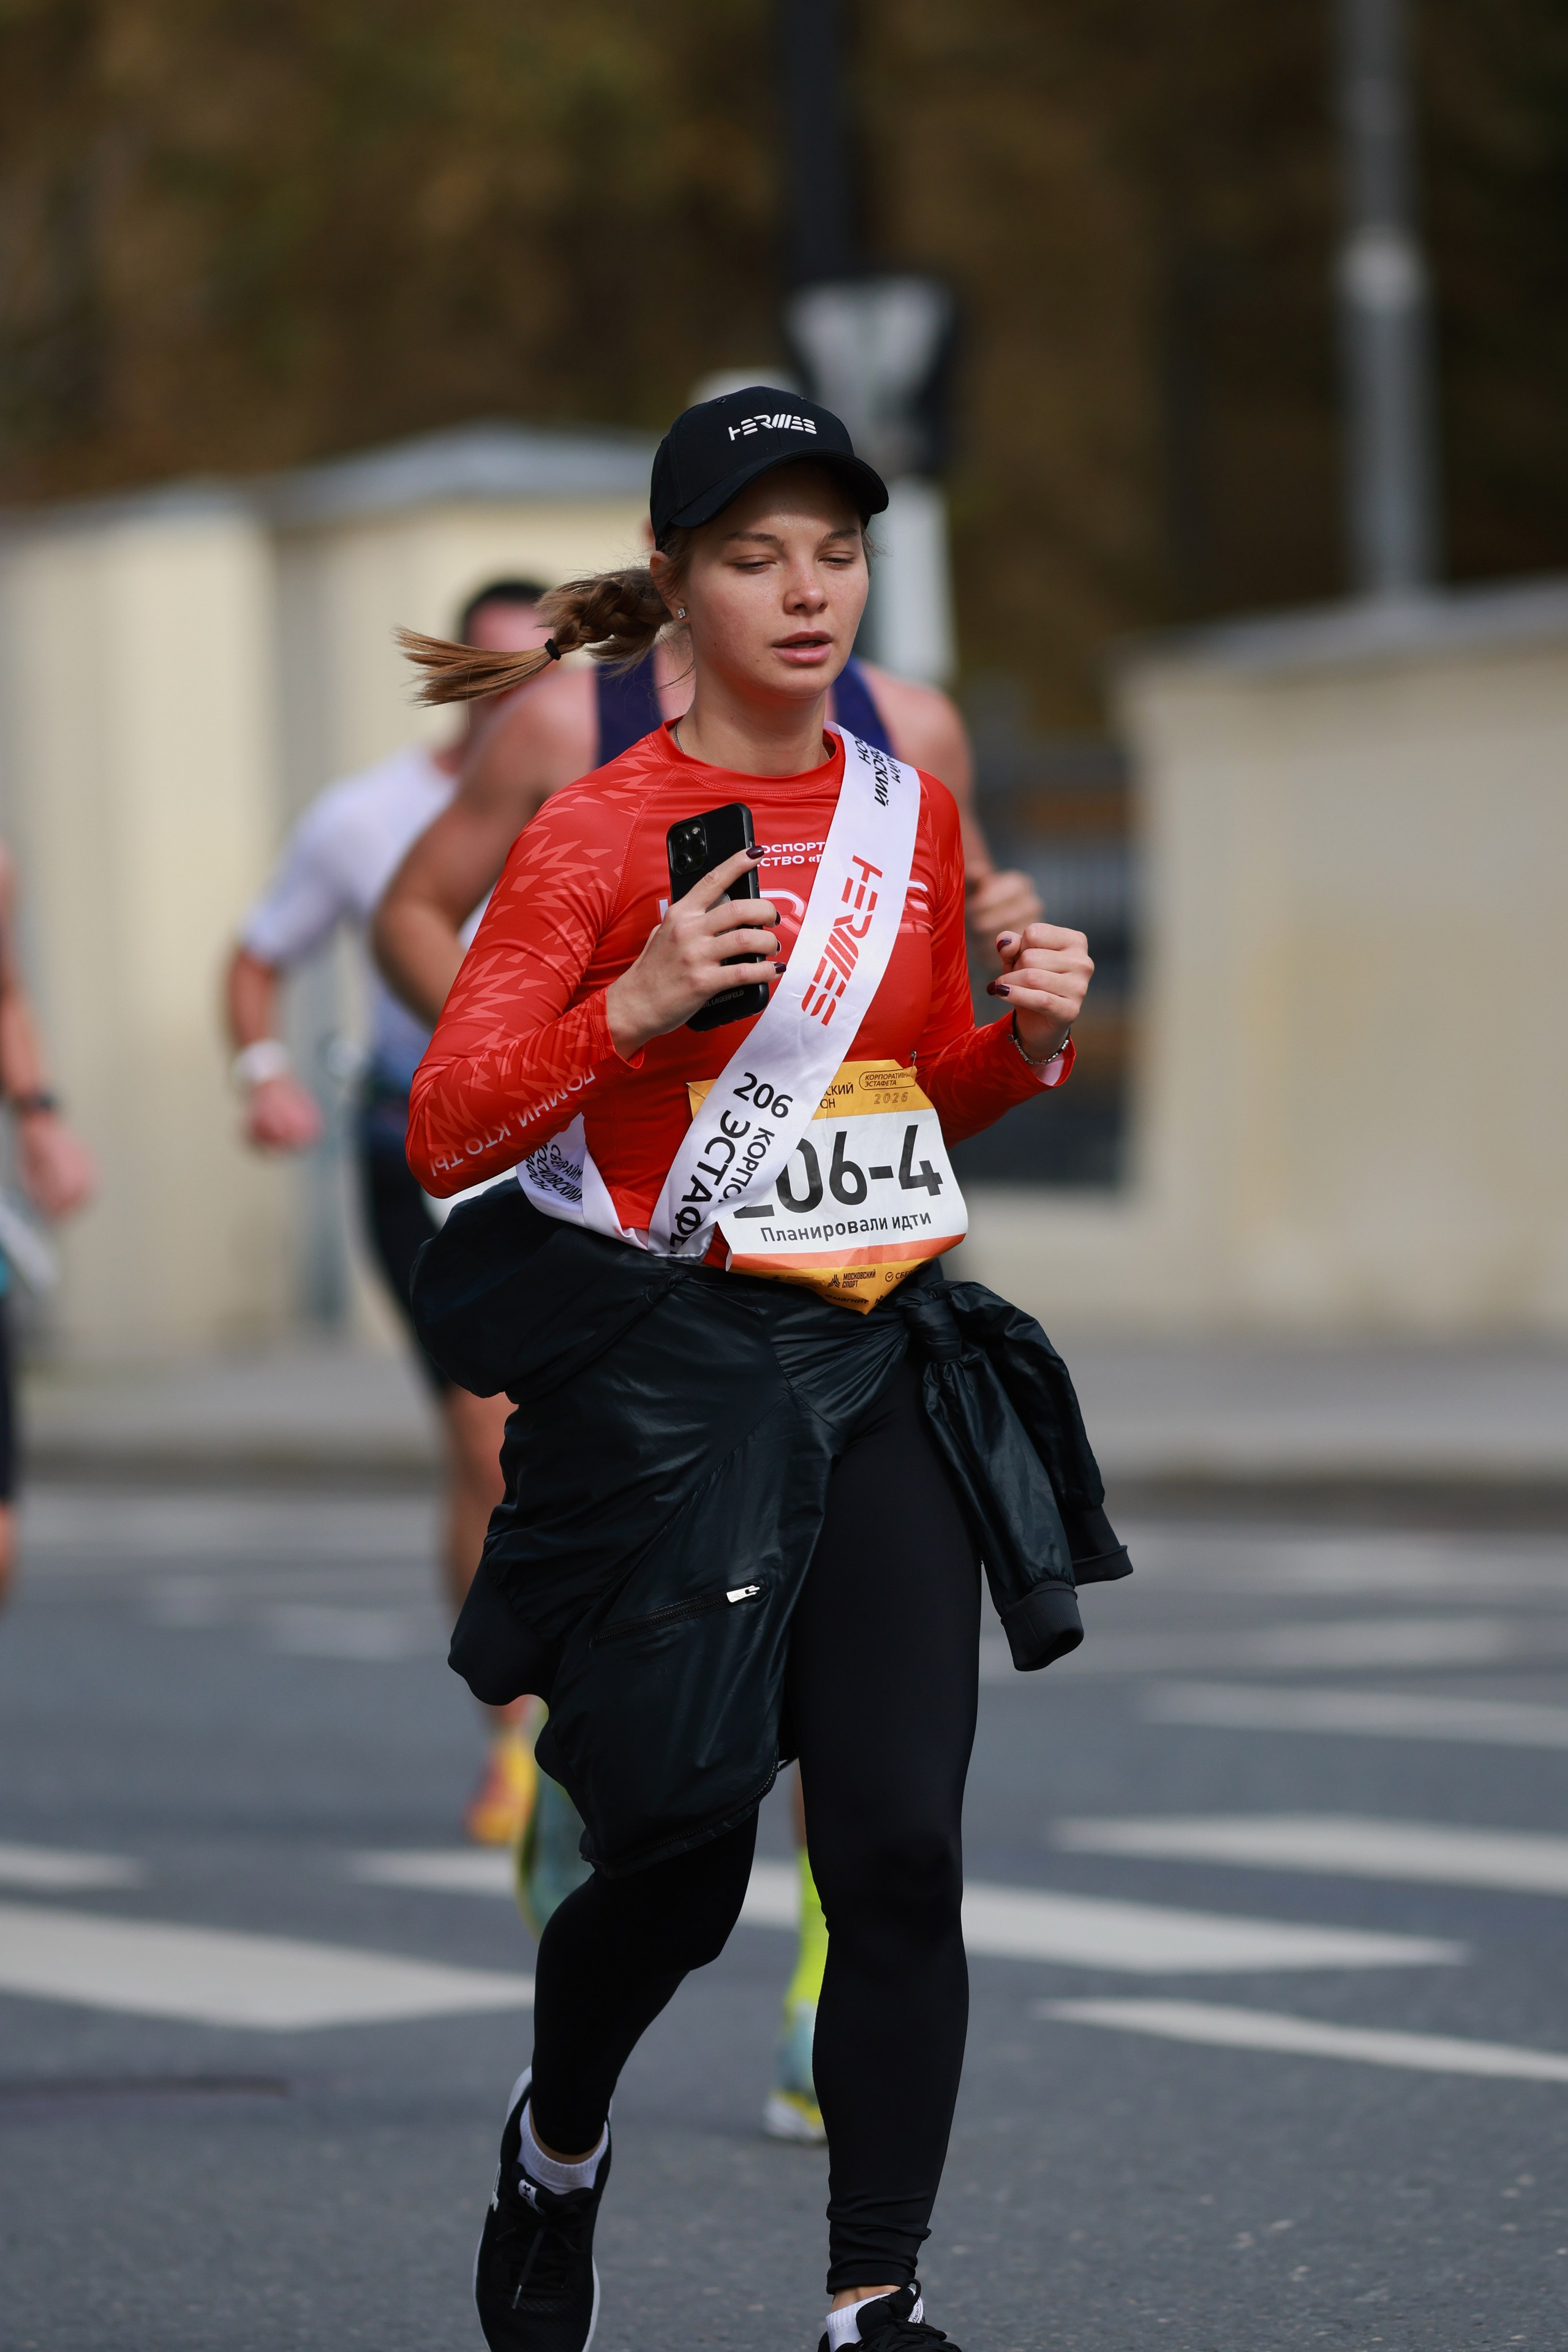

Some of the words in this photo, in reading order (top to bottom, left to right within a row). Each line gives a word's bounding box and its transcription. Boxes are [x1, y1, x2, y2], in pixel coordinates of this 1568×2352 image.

[728, 413, 817, 441] HERMES
[760, 841, 826, 854] ОСПОРТ
[801, 854, 883, 1027] HERMES
[733, 1072, 794, 1118] 206
[820, 1098, 836, 1109] ОН
[873, 1091, 909, 1104] 2026
[464, 1120, 511, 1155] КТО
[431, 1149, 464, 1177] ТЫ
[760, 1216, 889, 1243] Планировали
[891, 1212, 932, 1231] идти
[842, 1280, 859, 1288] СПОРТ
[843, 1269, 876, 1281] МОСКОВСКИЙ
